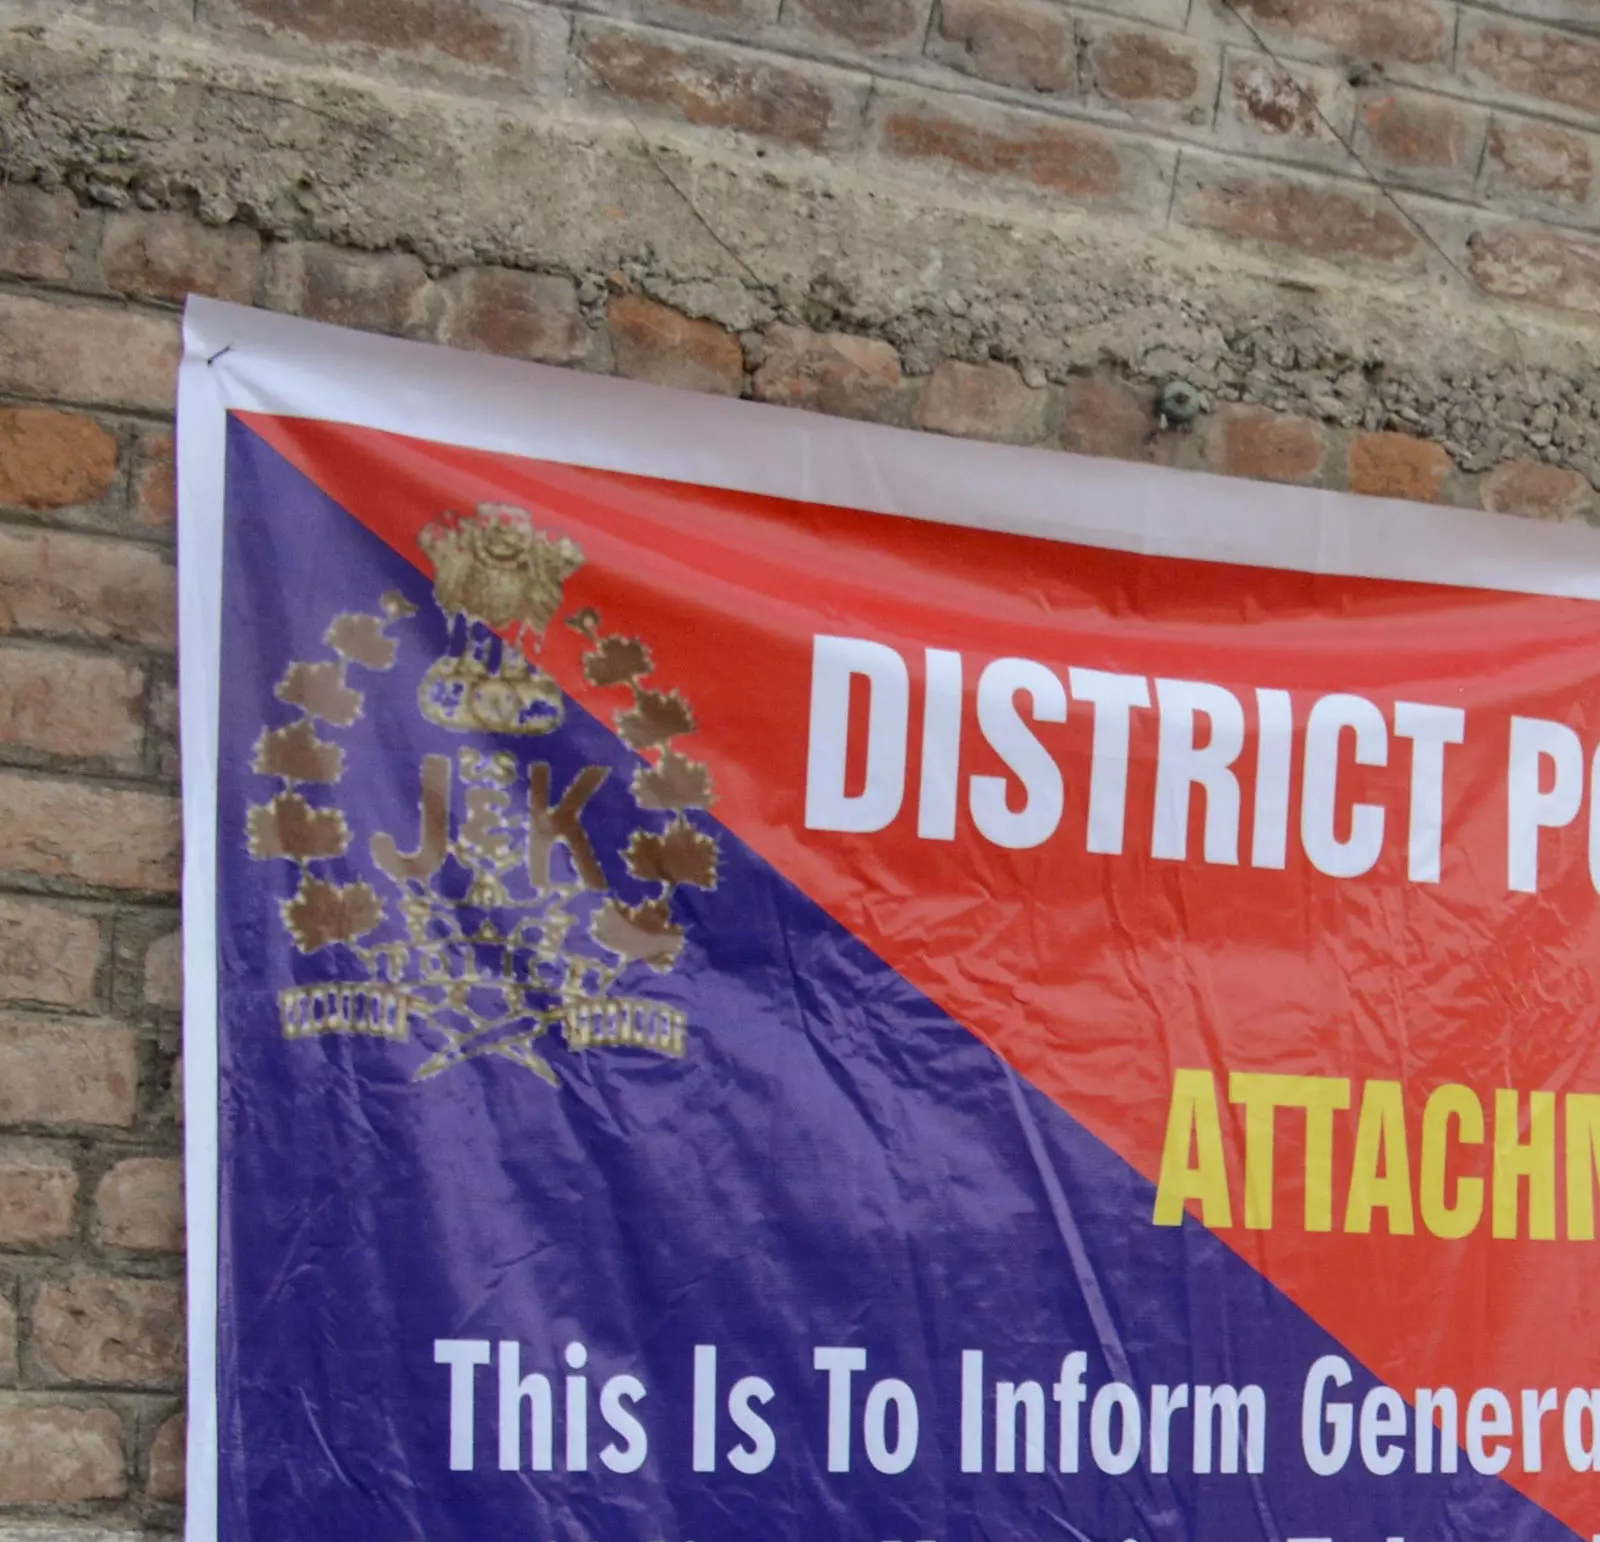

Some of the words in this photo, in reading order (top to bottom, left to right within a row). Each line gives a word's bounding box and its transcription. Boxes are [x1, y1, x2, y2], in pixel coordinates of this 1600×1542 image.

[804, 632, 1466, 885] DISTRICT
[434, 1339, 648, 1474] This
[692, 1344, 776, 1474] Is
[813, 1346, 919, 1475] To
[961, 1349, 1266, 1475] Inform
